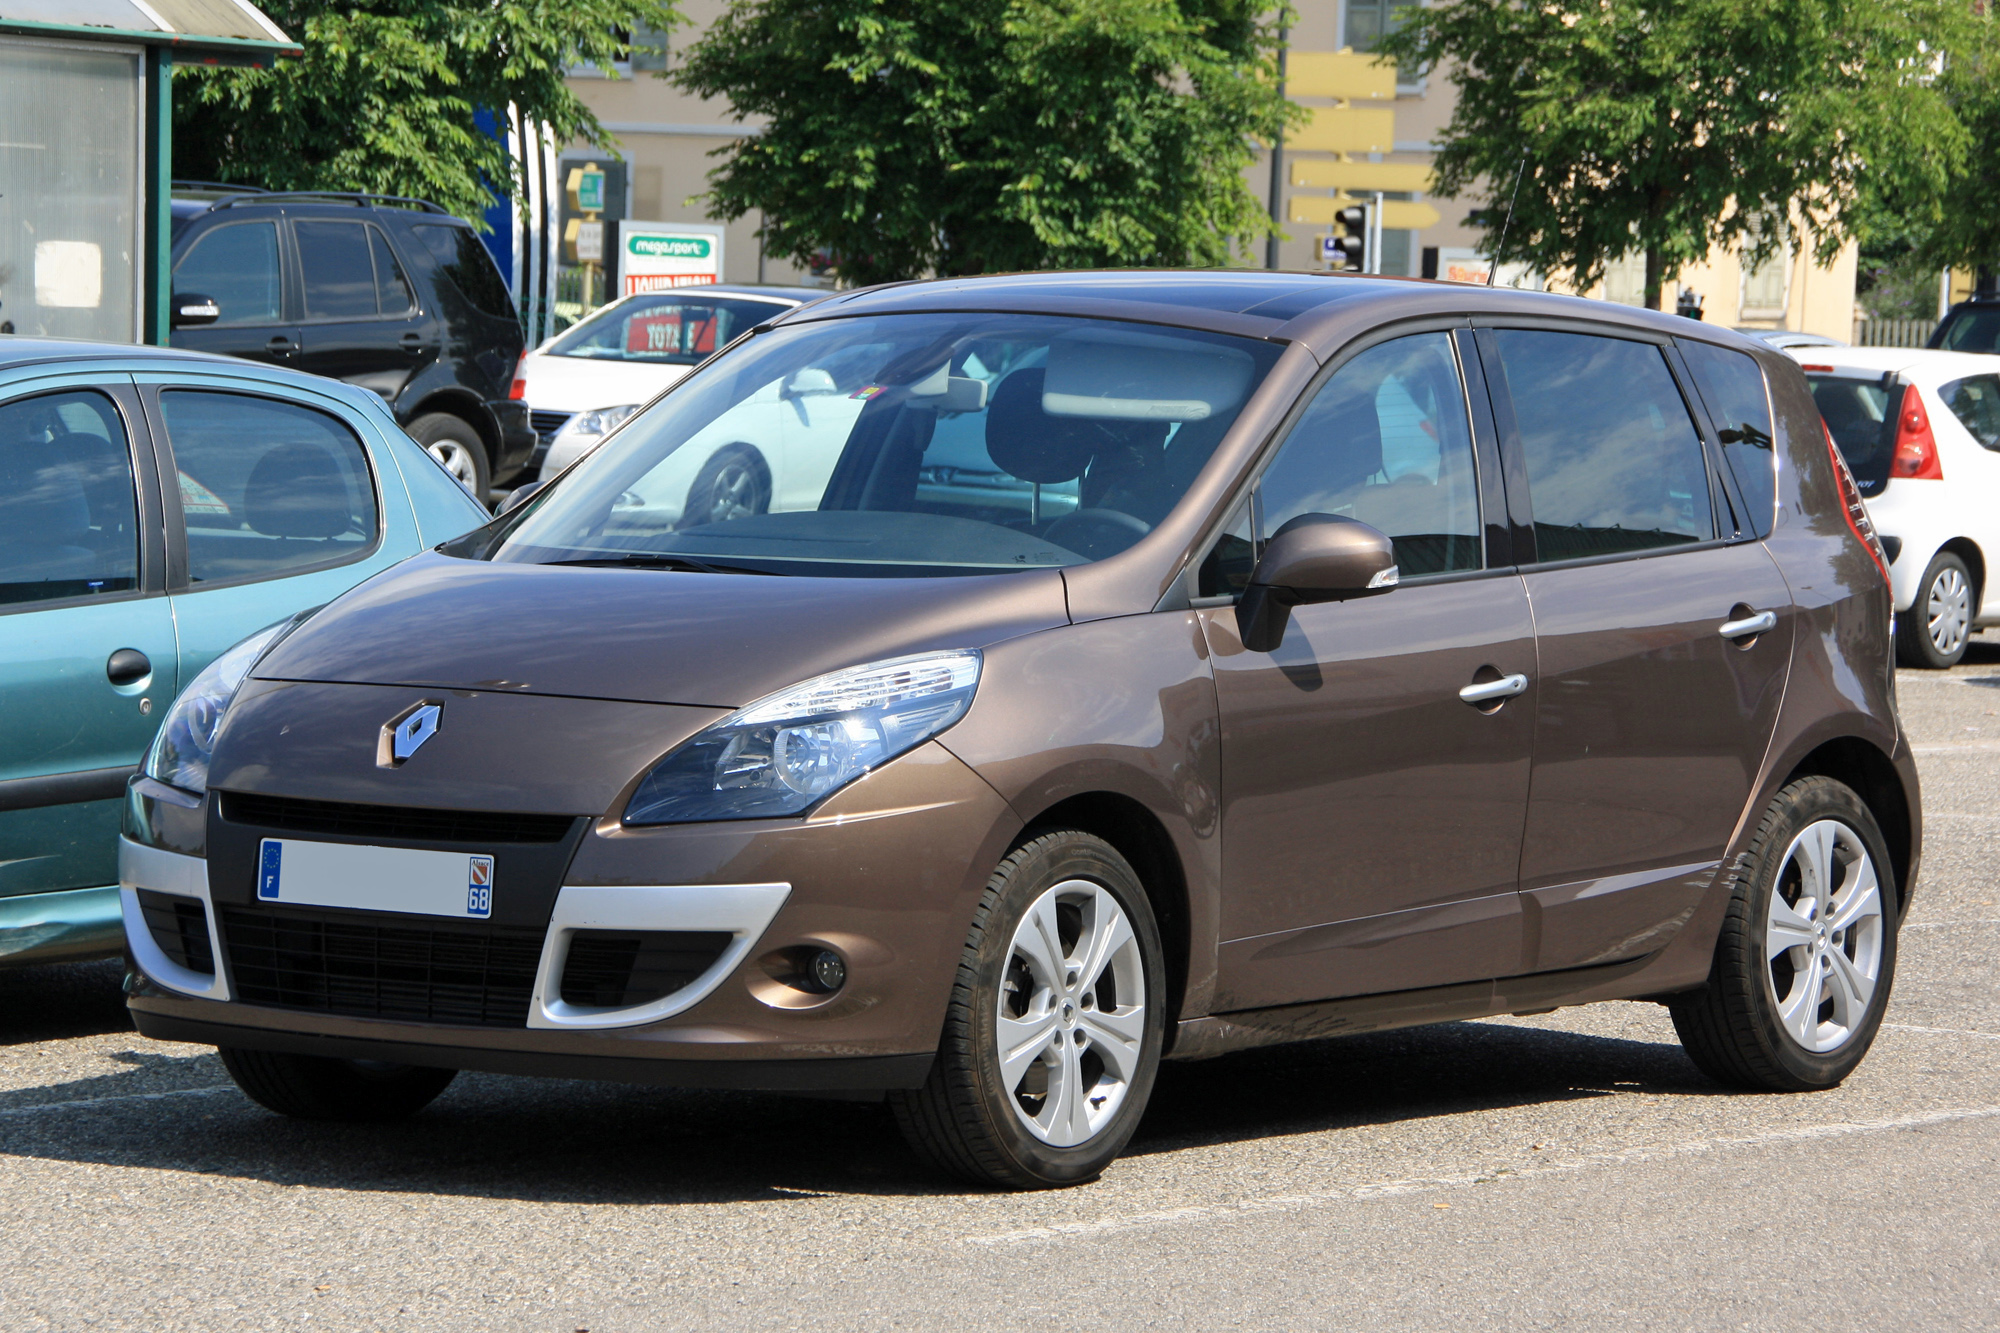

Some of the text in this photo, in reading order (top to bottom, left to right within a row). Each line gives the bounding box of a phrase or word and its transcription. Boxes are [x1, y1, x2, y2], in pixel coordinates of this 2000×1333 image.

[636, 240, 700, 255] megasport
[646, 322, 695, 350] TOTAE
[472, 859, 489, 867] Alsace
[265, 875, 274, 889] F
[469, 887, 489, 911] 68
